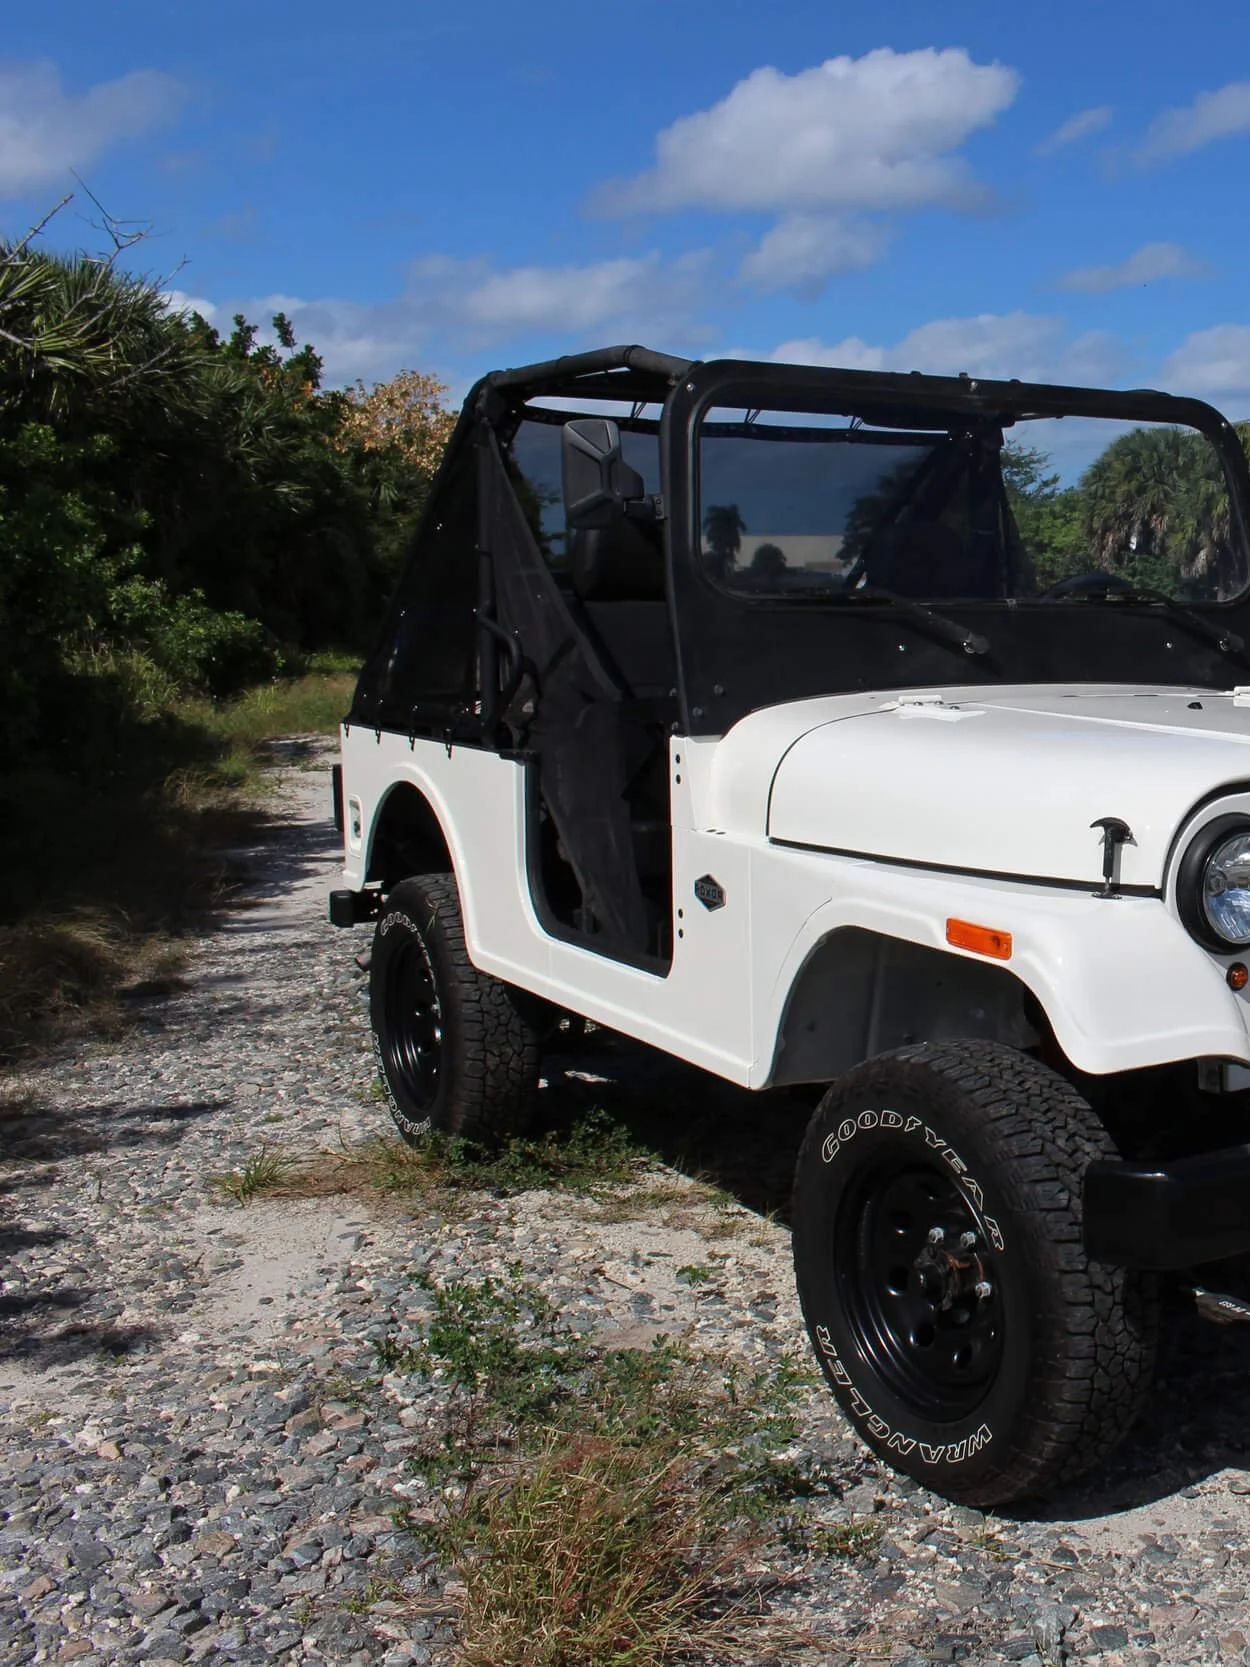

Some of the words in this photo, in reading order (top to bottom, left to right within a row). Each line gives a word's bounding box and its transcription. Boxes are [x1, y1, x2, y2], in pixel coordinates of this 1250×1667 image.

[380, 911, 442, 1020] GOOD
[820, 1109, 1006, 1252] GOODYEAR
[815, 1323, 994, 1465] WRANGLER
